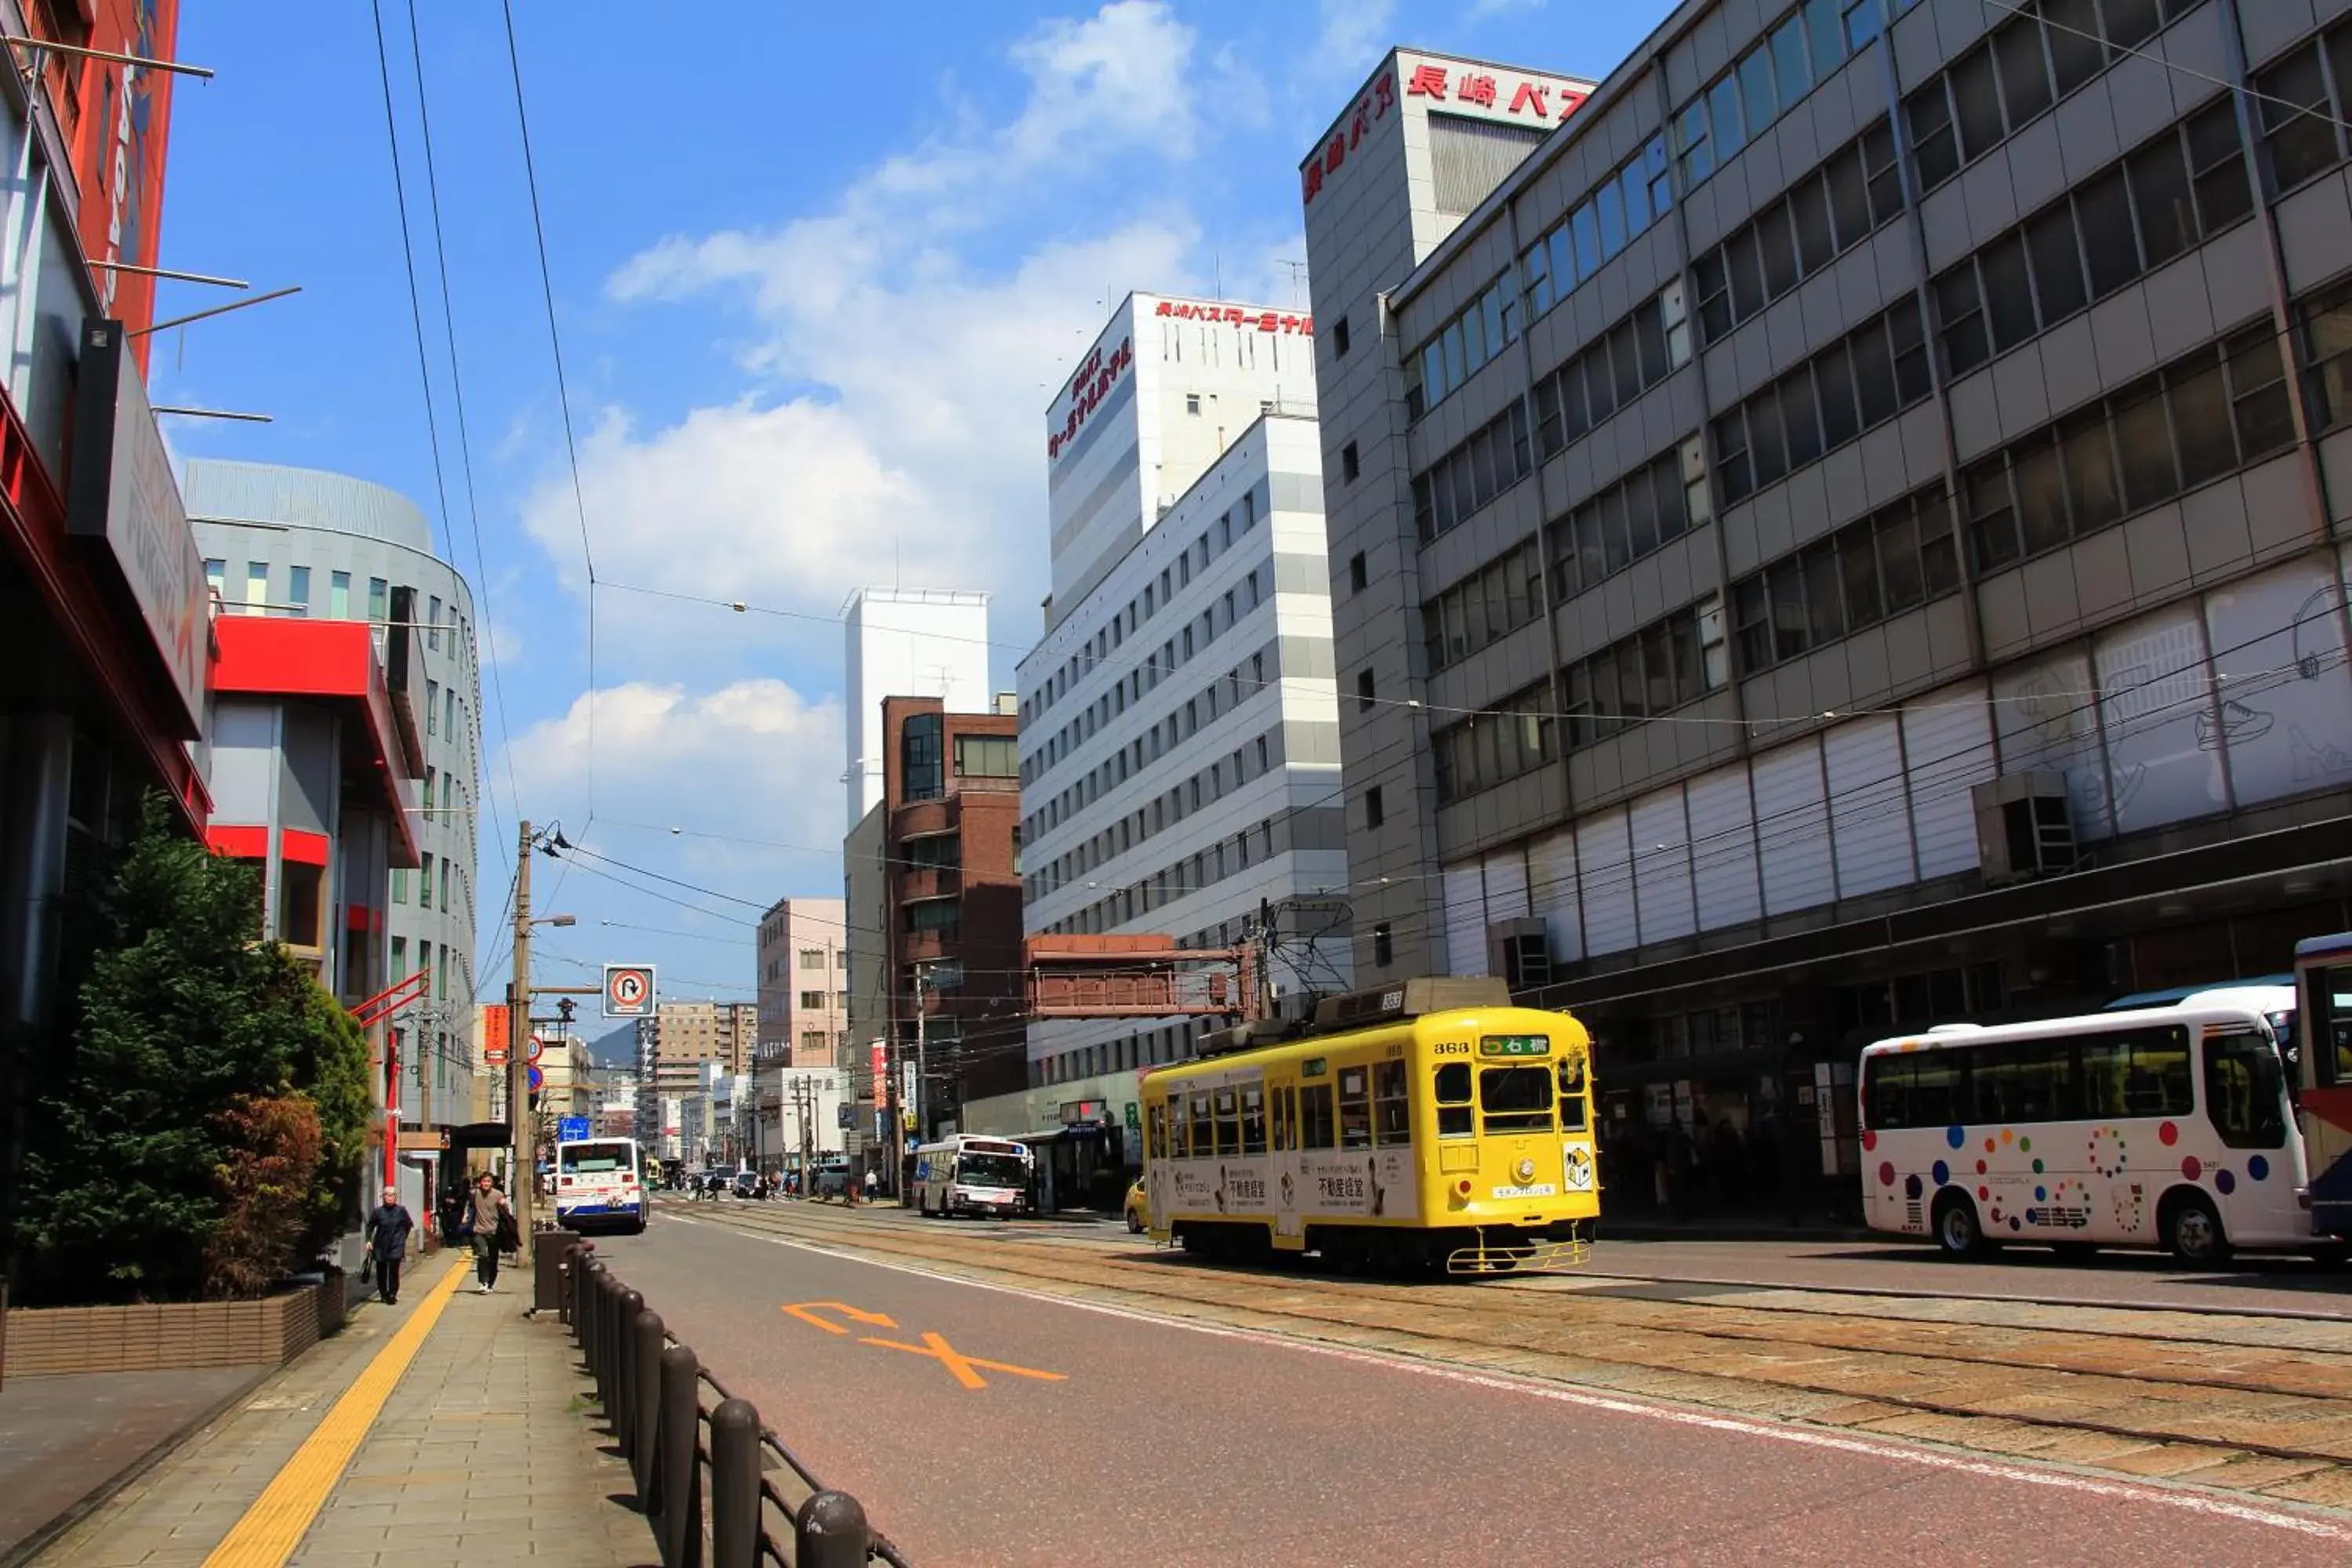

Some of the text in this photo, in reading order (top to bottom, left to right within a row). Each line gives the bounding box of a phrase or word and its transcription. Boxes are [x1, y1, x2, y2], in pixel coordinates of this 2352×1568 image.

[1406, 64, 1589, 122] 長崎バス
[1304, 71, 1395, 205] 長崎バス
[1506, 1038, 1548, 1053] 石橋
